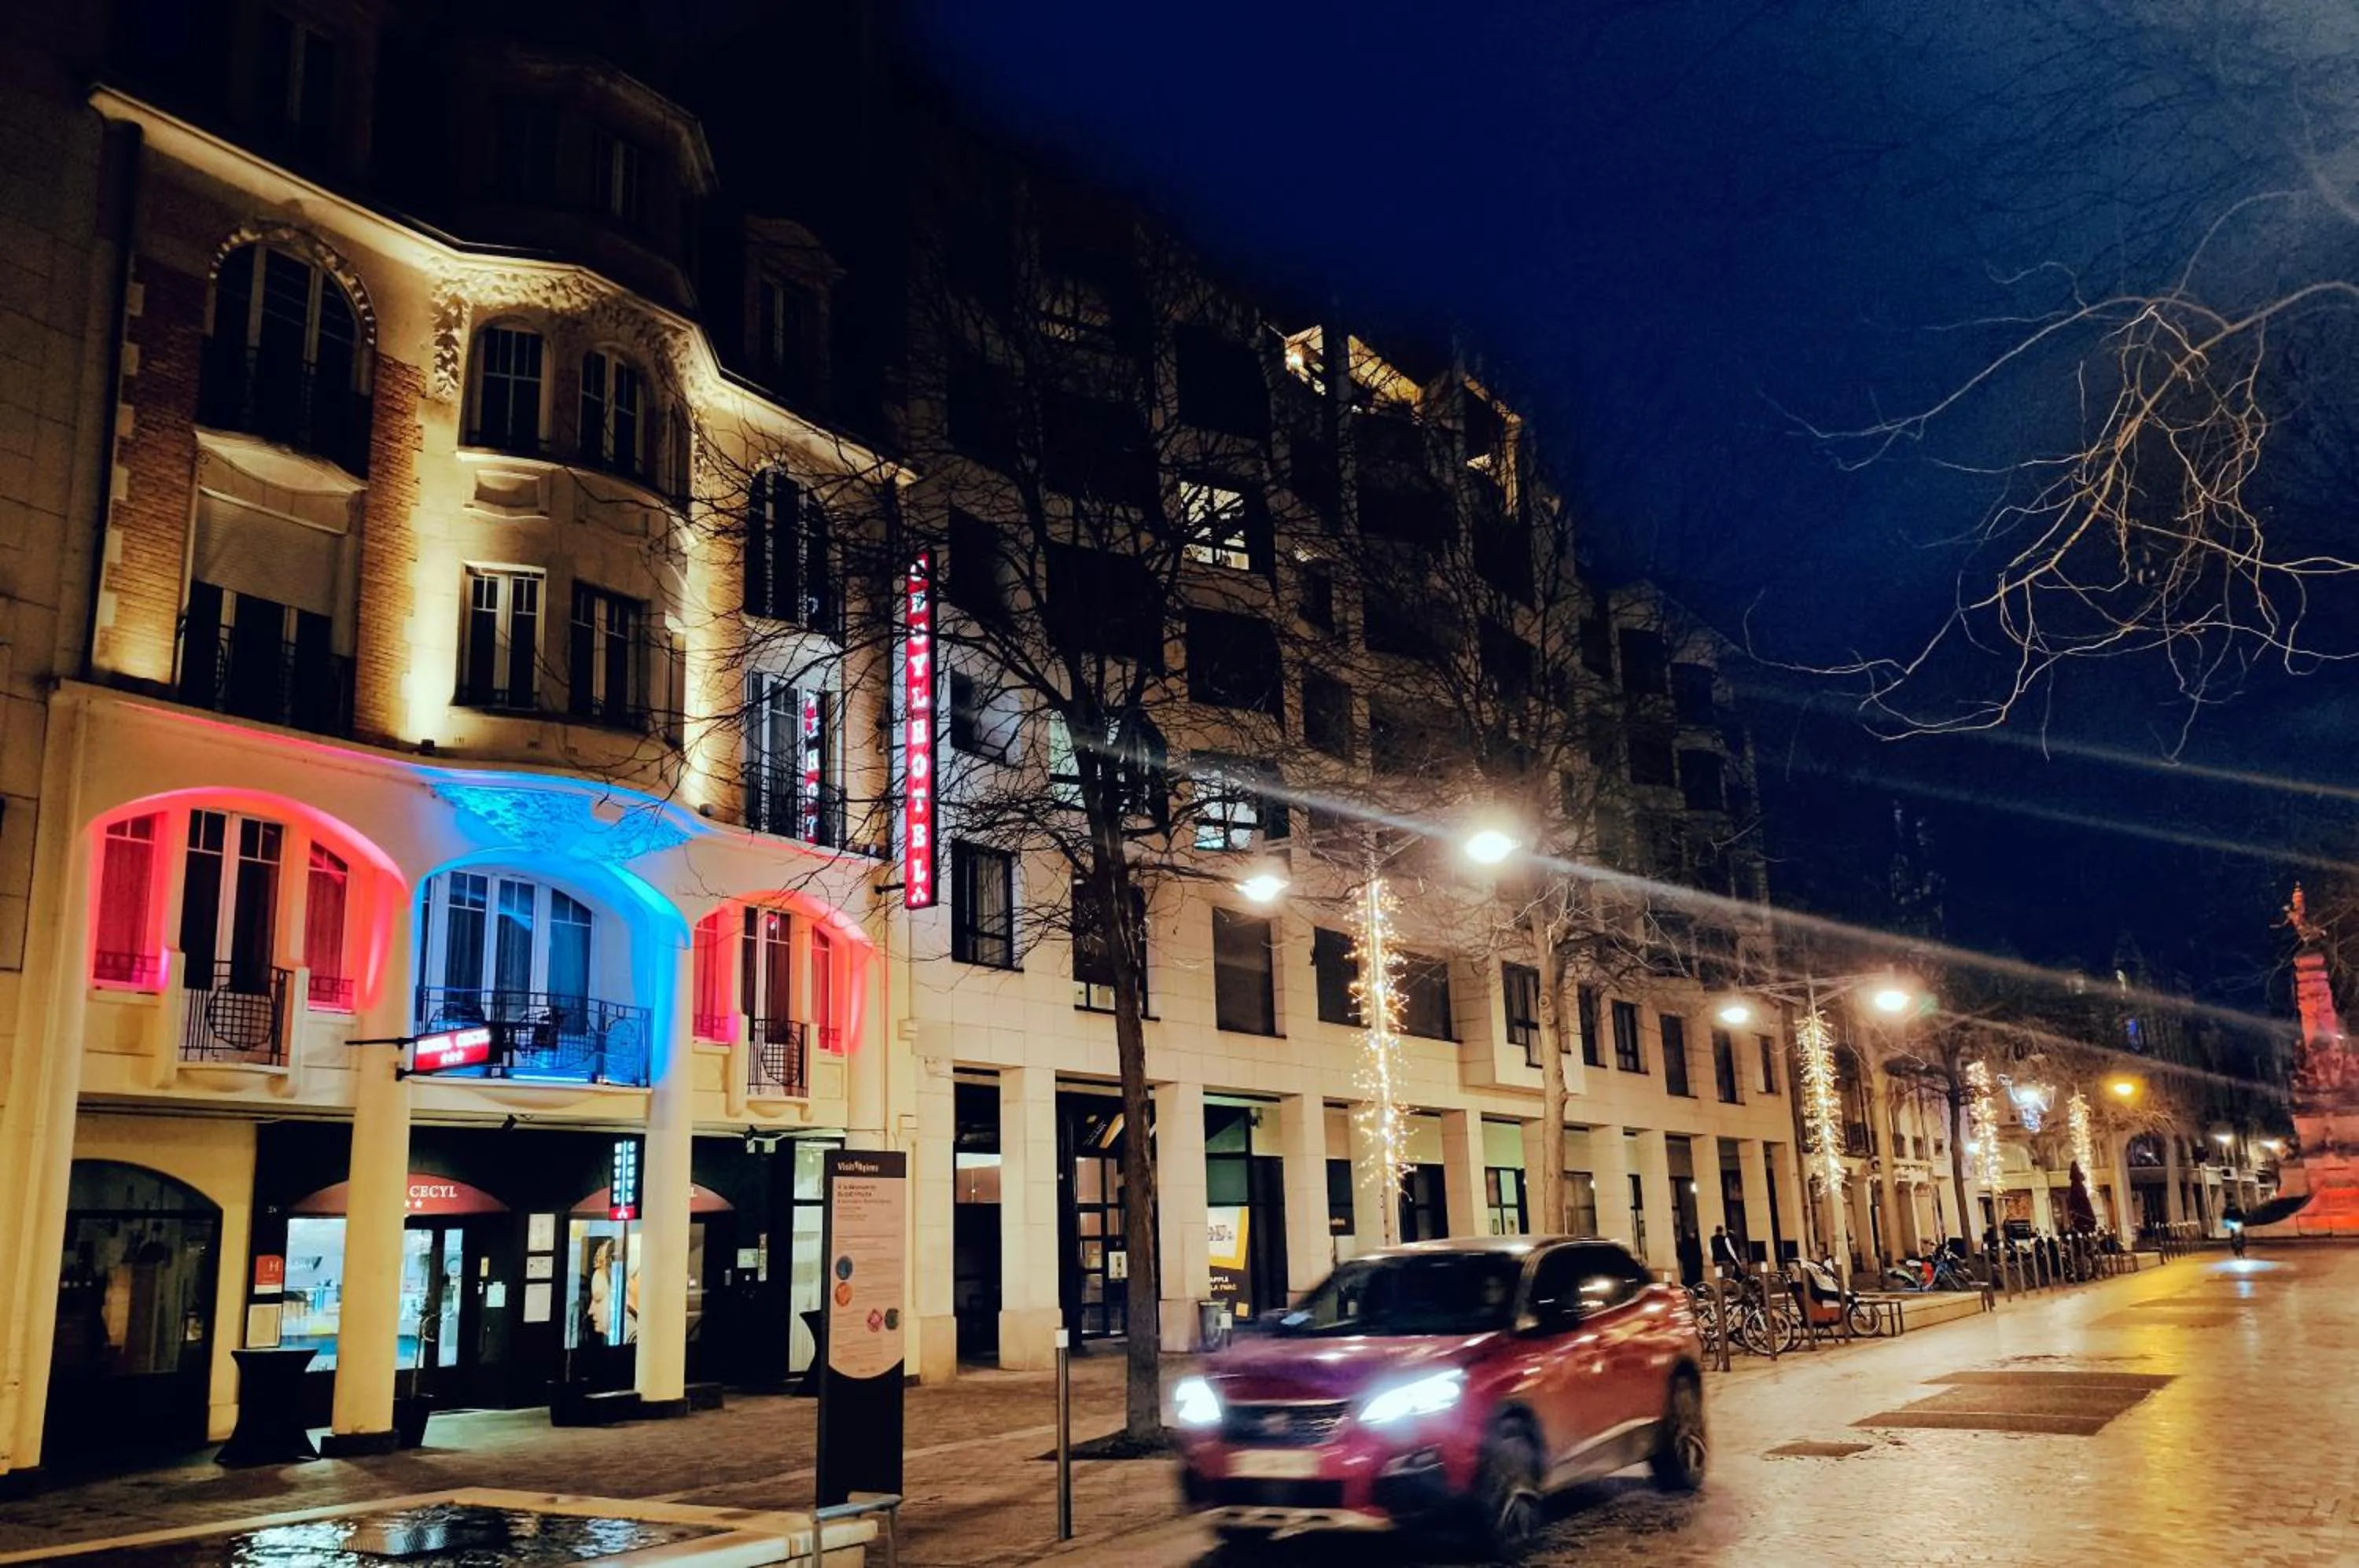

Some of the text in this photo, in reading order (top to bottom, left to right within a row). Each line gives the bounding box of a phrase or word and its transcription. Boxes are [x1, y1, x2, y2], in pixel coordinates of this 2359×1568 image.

[911, 719, 927, 883] HOTEL
[409, 1185, 458, 1198] CECYL
[613, 1142, 622, 1204] HOTEL
